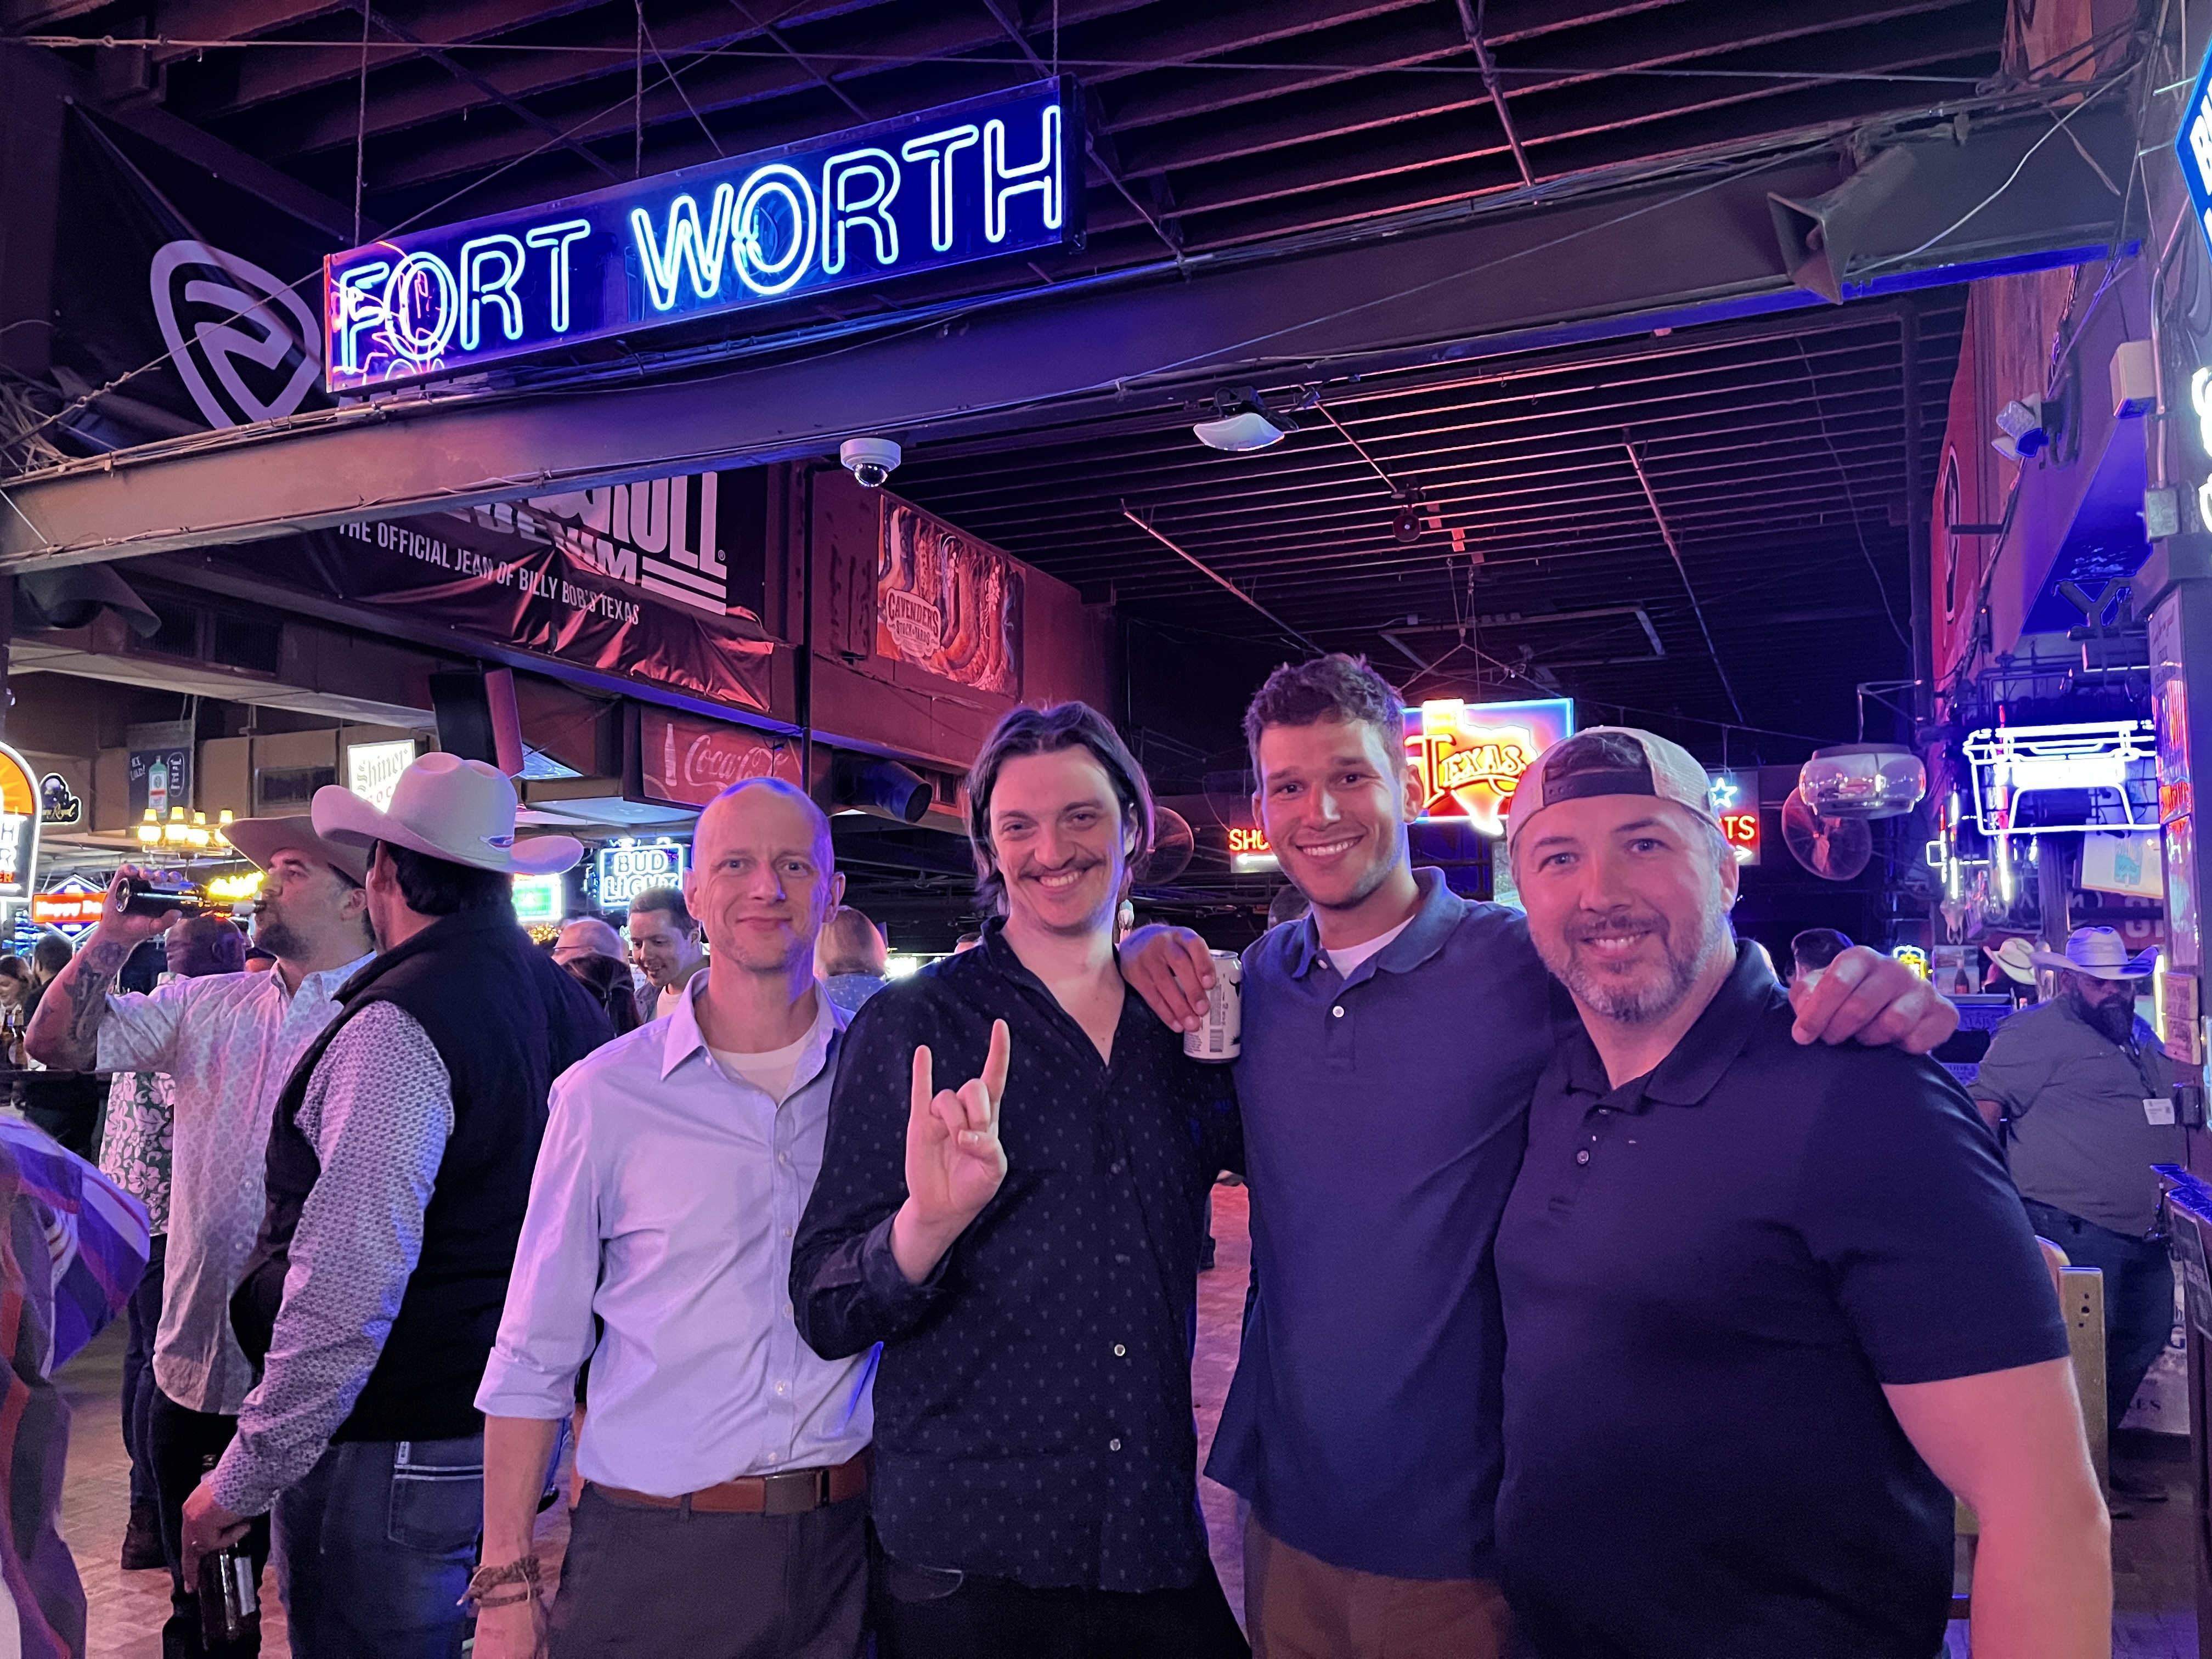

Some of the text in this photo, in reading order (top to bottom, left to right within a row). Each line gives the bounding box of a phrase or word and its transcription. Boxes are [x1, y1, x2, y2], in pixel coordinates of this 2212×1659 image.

[338, 105, 1062, 374] FORT WORTH
[377, 522, 450, 569] OFFICIAL
[455, 548, 494, 580] JEAN
[496, 561, 515, 586] OF
[519, 567, 558, 599] BILLY
[562, 580, 597, 612] BOB'S
[600, 593, 640, 625] TEXAS
[357, 748, 408, 792] Shiner
[1718, 815, 1756, 840] TS
[614, 850, 669, 876] BUD
